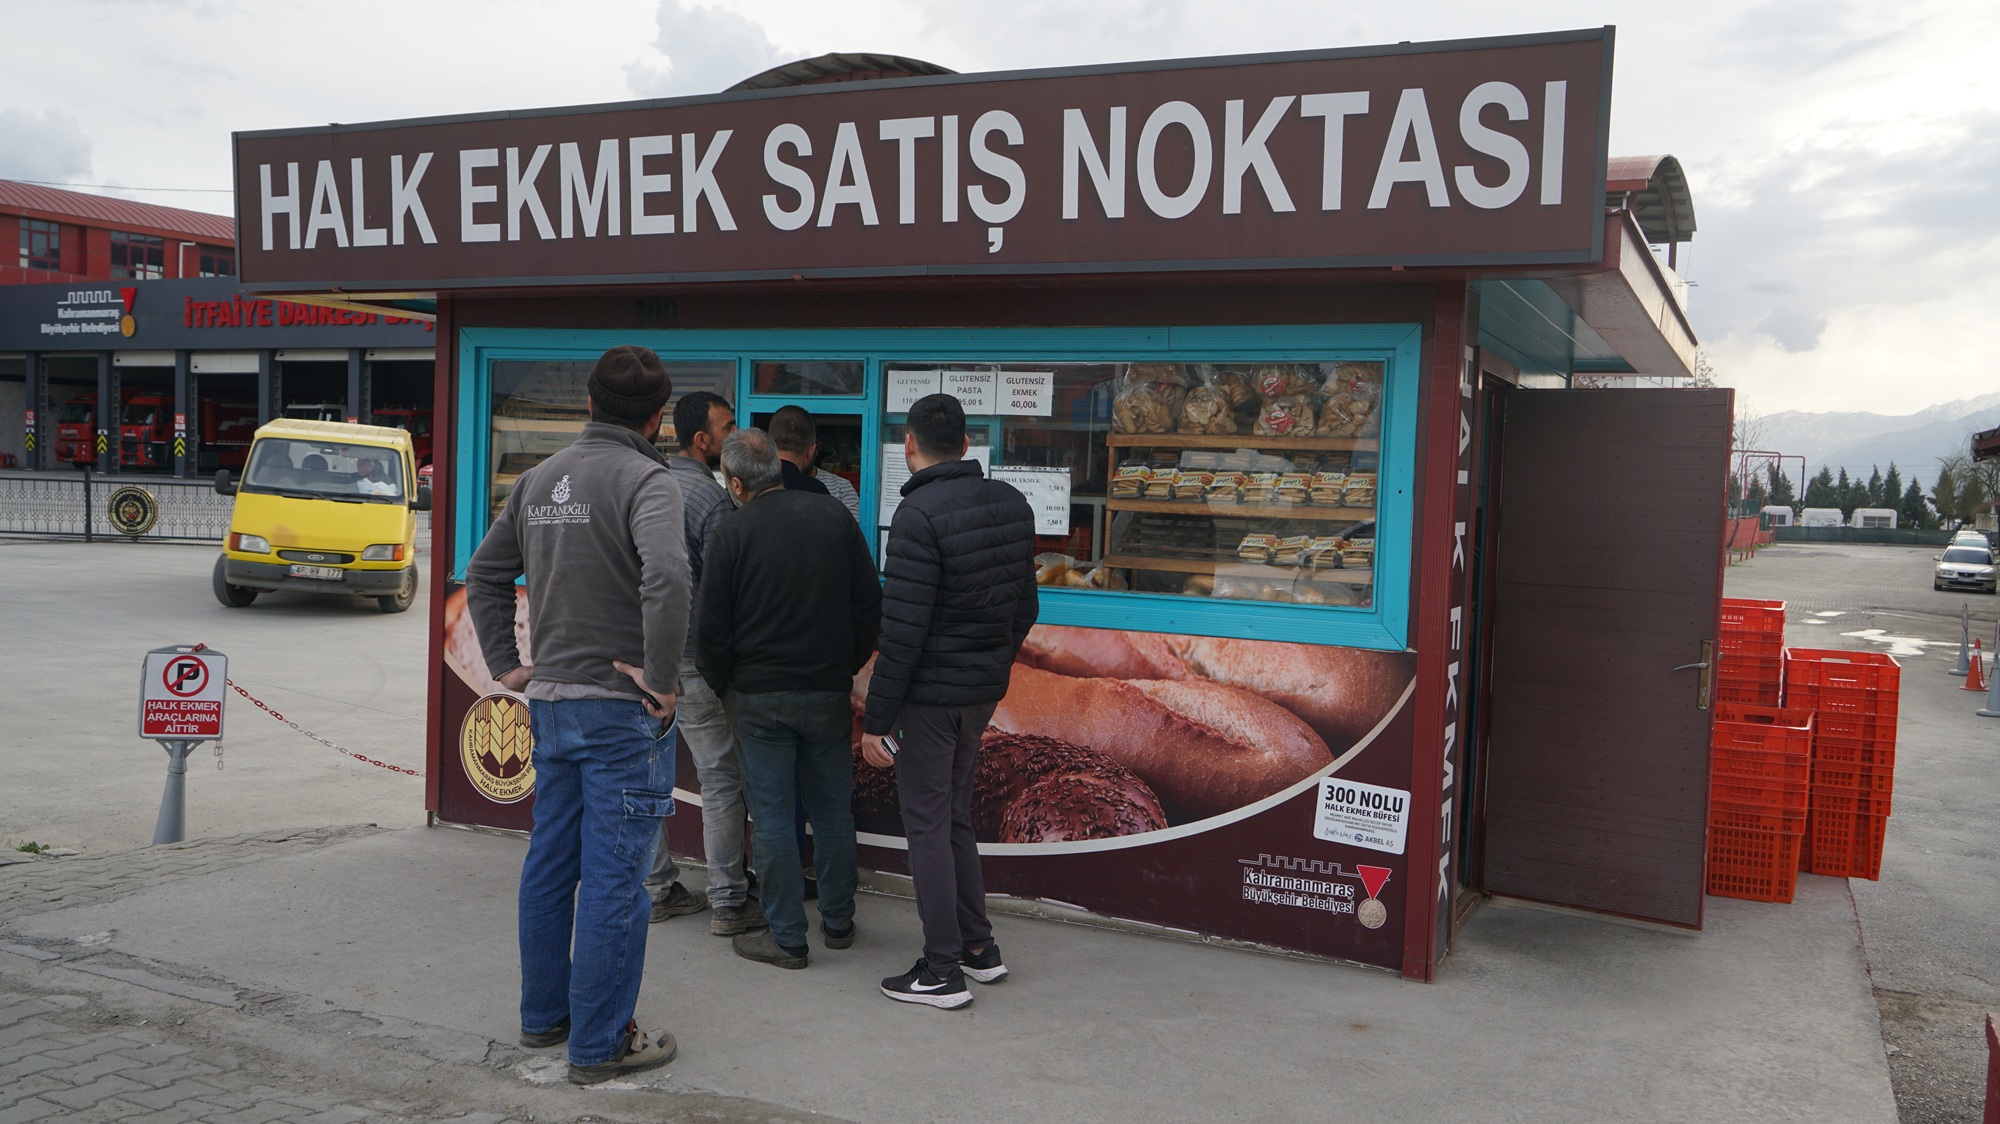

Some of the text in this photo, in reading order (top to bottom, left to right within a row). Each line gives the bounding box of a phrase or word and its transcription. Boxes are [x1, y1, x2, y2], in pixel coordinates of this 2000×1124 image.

[259, 79, 1566, 253] HALK EKMEK SATIŞ NOKTASI
[57, 308, 120, 320] Kahramanmaraş
[184, 294, 273, 328] İTFAİYE
[633, 298, 678, 326] 300
[41, 322, 119, 335] Büyükşehir Belediyesi
[949, 374, 991, 383] GLUTENSİZ
[1006, 376, 1045, 385] GLUTENSİZ
[1012, 389, 1038, 397] EKMEK
[176, 416, 185, 424] 112
[527, 502, 591, 517] KAPTANOĞLU
[147, 701, 219, 711] HALK EKMEK
[147, 712, 218, 723] ARAÇLARINA
[468, 729, 495, 784] KAHRAMANMARAŞ
[480, 778, 524, 796] HALK EKMEK
[1325, 785, 1404, 813] 300 NOLU
[1324, 802, 1400, 823] HALK EKMEK BÜFESİ
[1365, 836, 1385, 846] AKBEL
[1244, 866, 1355, 900] Kahramanmaraş
[1242, 886, 1355, 915] Büyükşehir Belediyesi
